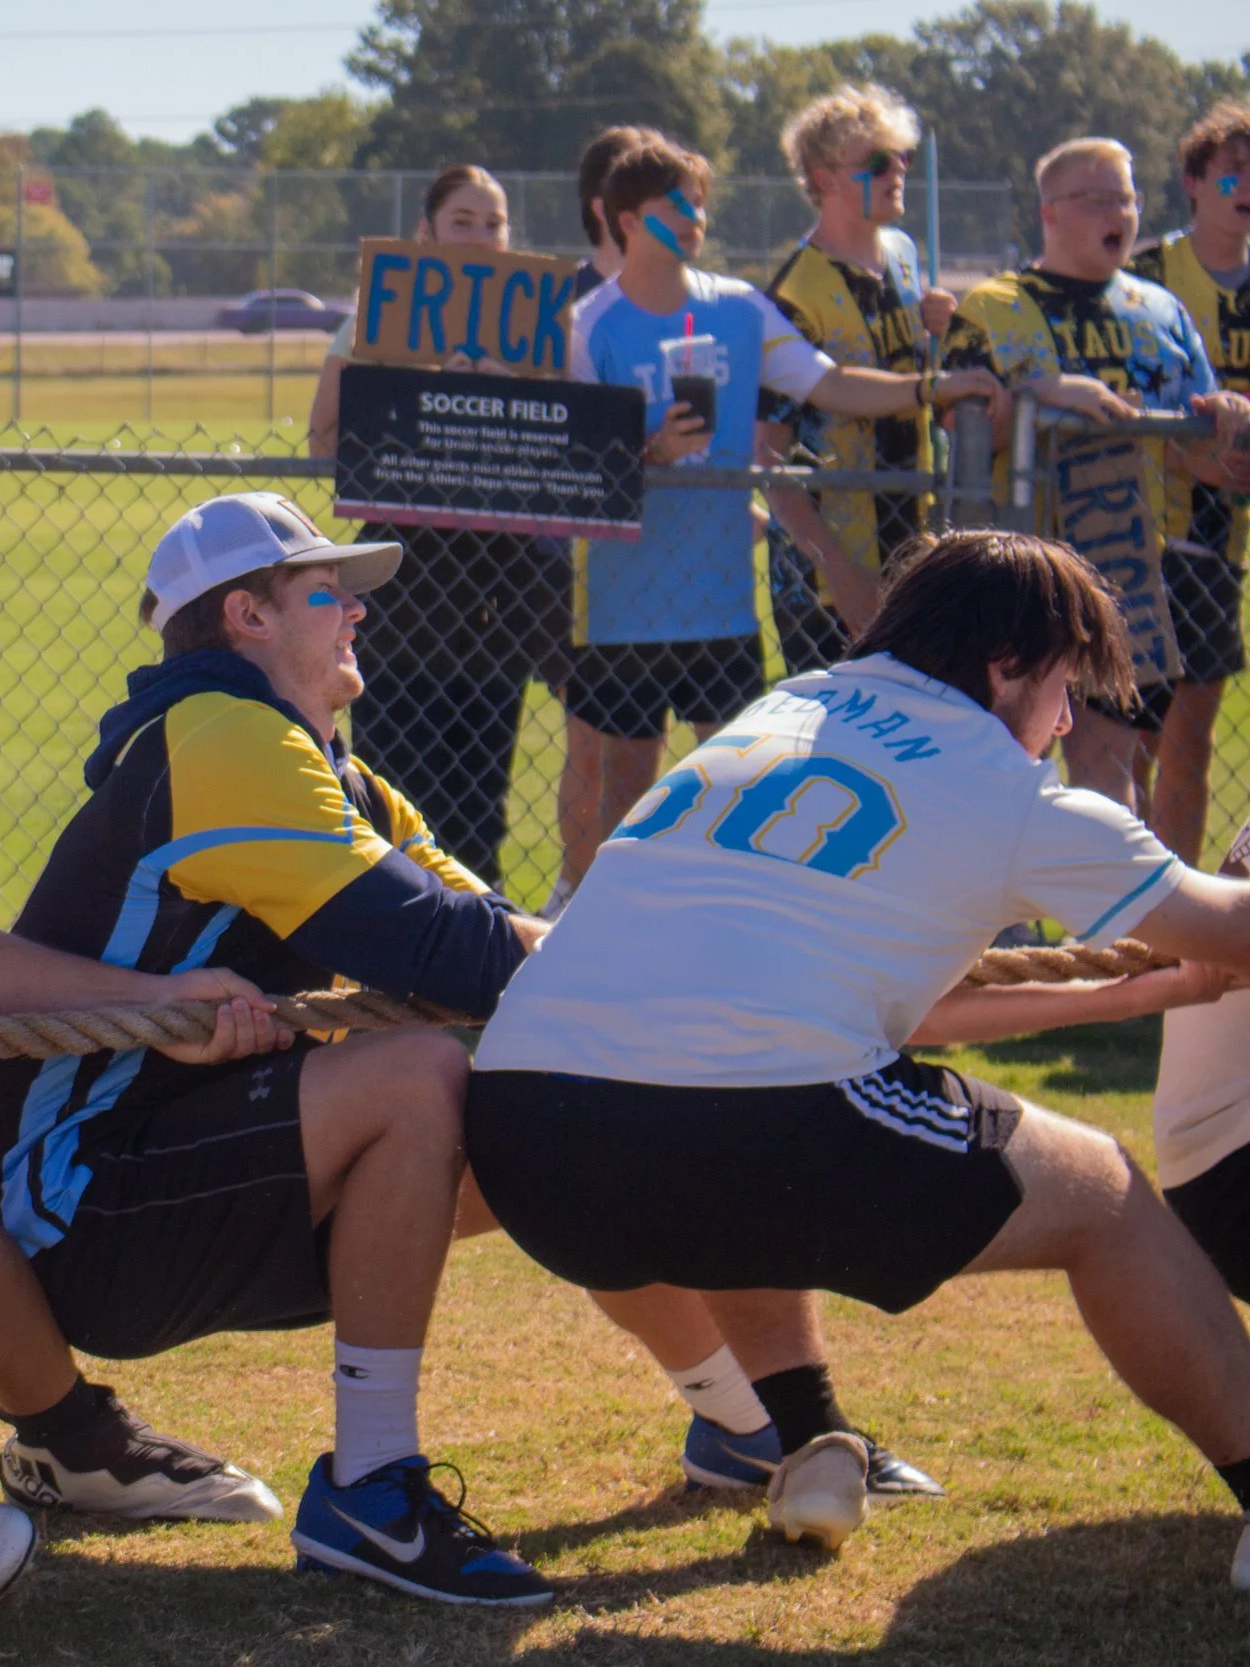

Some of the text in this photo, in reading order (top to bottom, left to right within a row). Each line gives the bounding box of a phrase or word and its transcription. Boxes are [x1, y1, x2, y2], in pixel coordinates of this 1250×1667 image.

[365, 252, 576, 370] FRICK
[870, 306, 917, 358] TAU
[1052, 318, 1161, 364] TAUS
[419, 392, 569, 423] SOCCER FIELD
[419, 420, 569, 446] This soccer field is reserved
[381, 453, 398, 465] All
[400, 455, 430, 467] other
[405, 468, 424, 481] the
